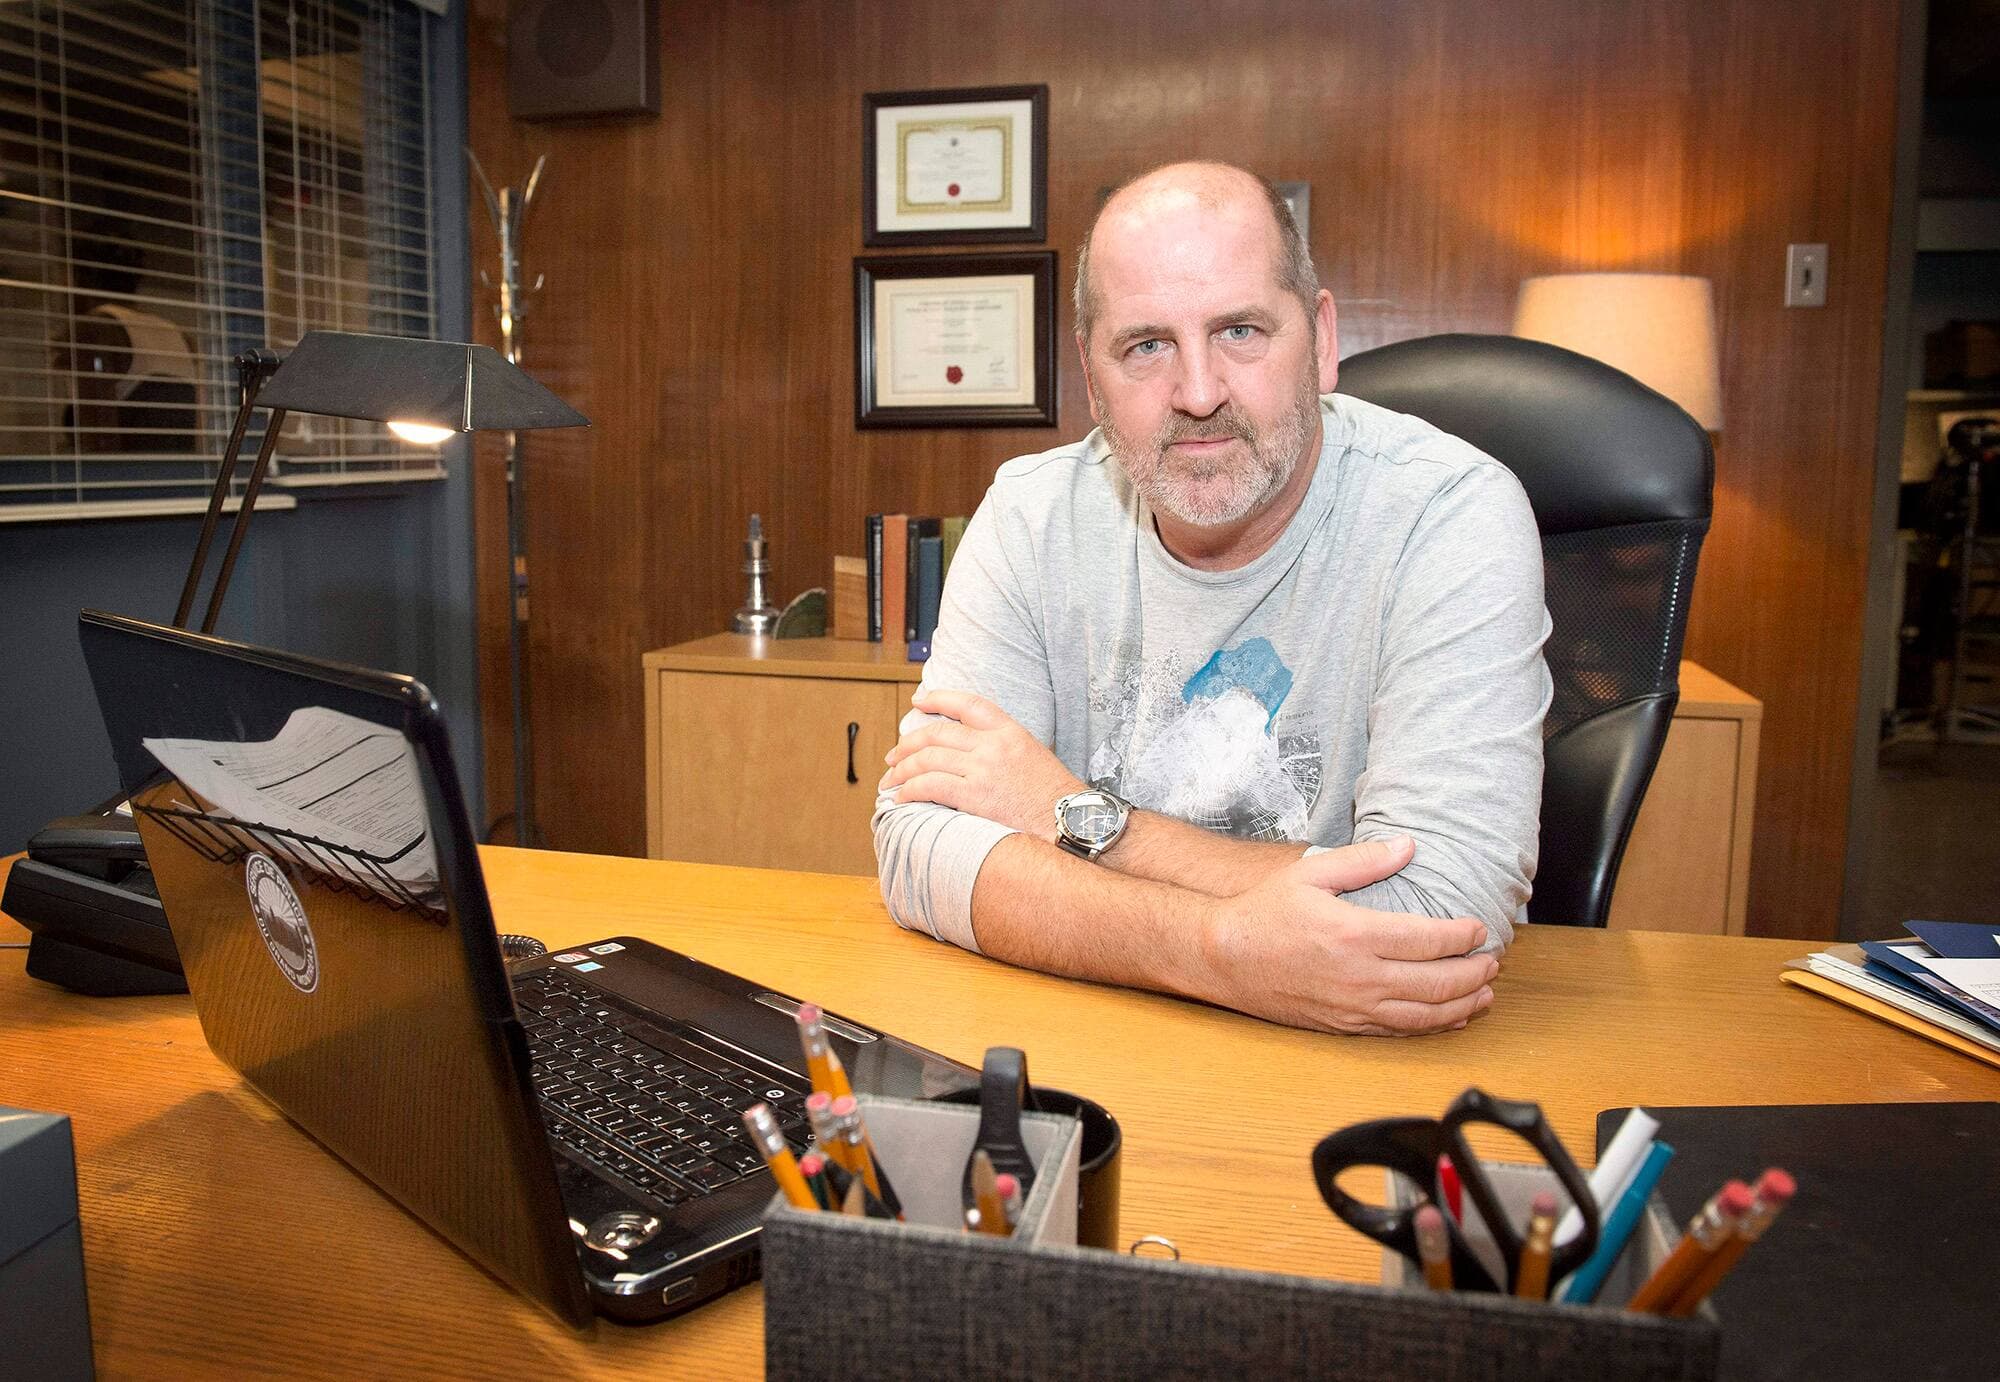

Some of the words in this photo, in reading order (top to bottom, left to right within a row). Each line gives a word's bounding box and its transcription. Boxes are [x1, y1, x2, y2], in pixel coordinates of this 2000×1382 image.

[263, 861, 275, 879] DE
[276, 875, 304, 926] POLICE
[259, 917, 269, 937] DU
